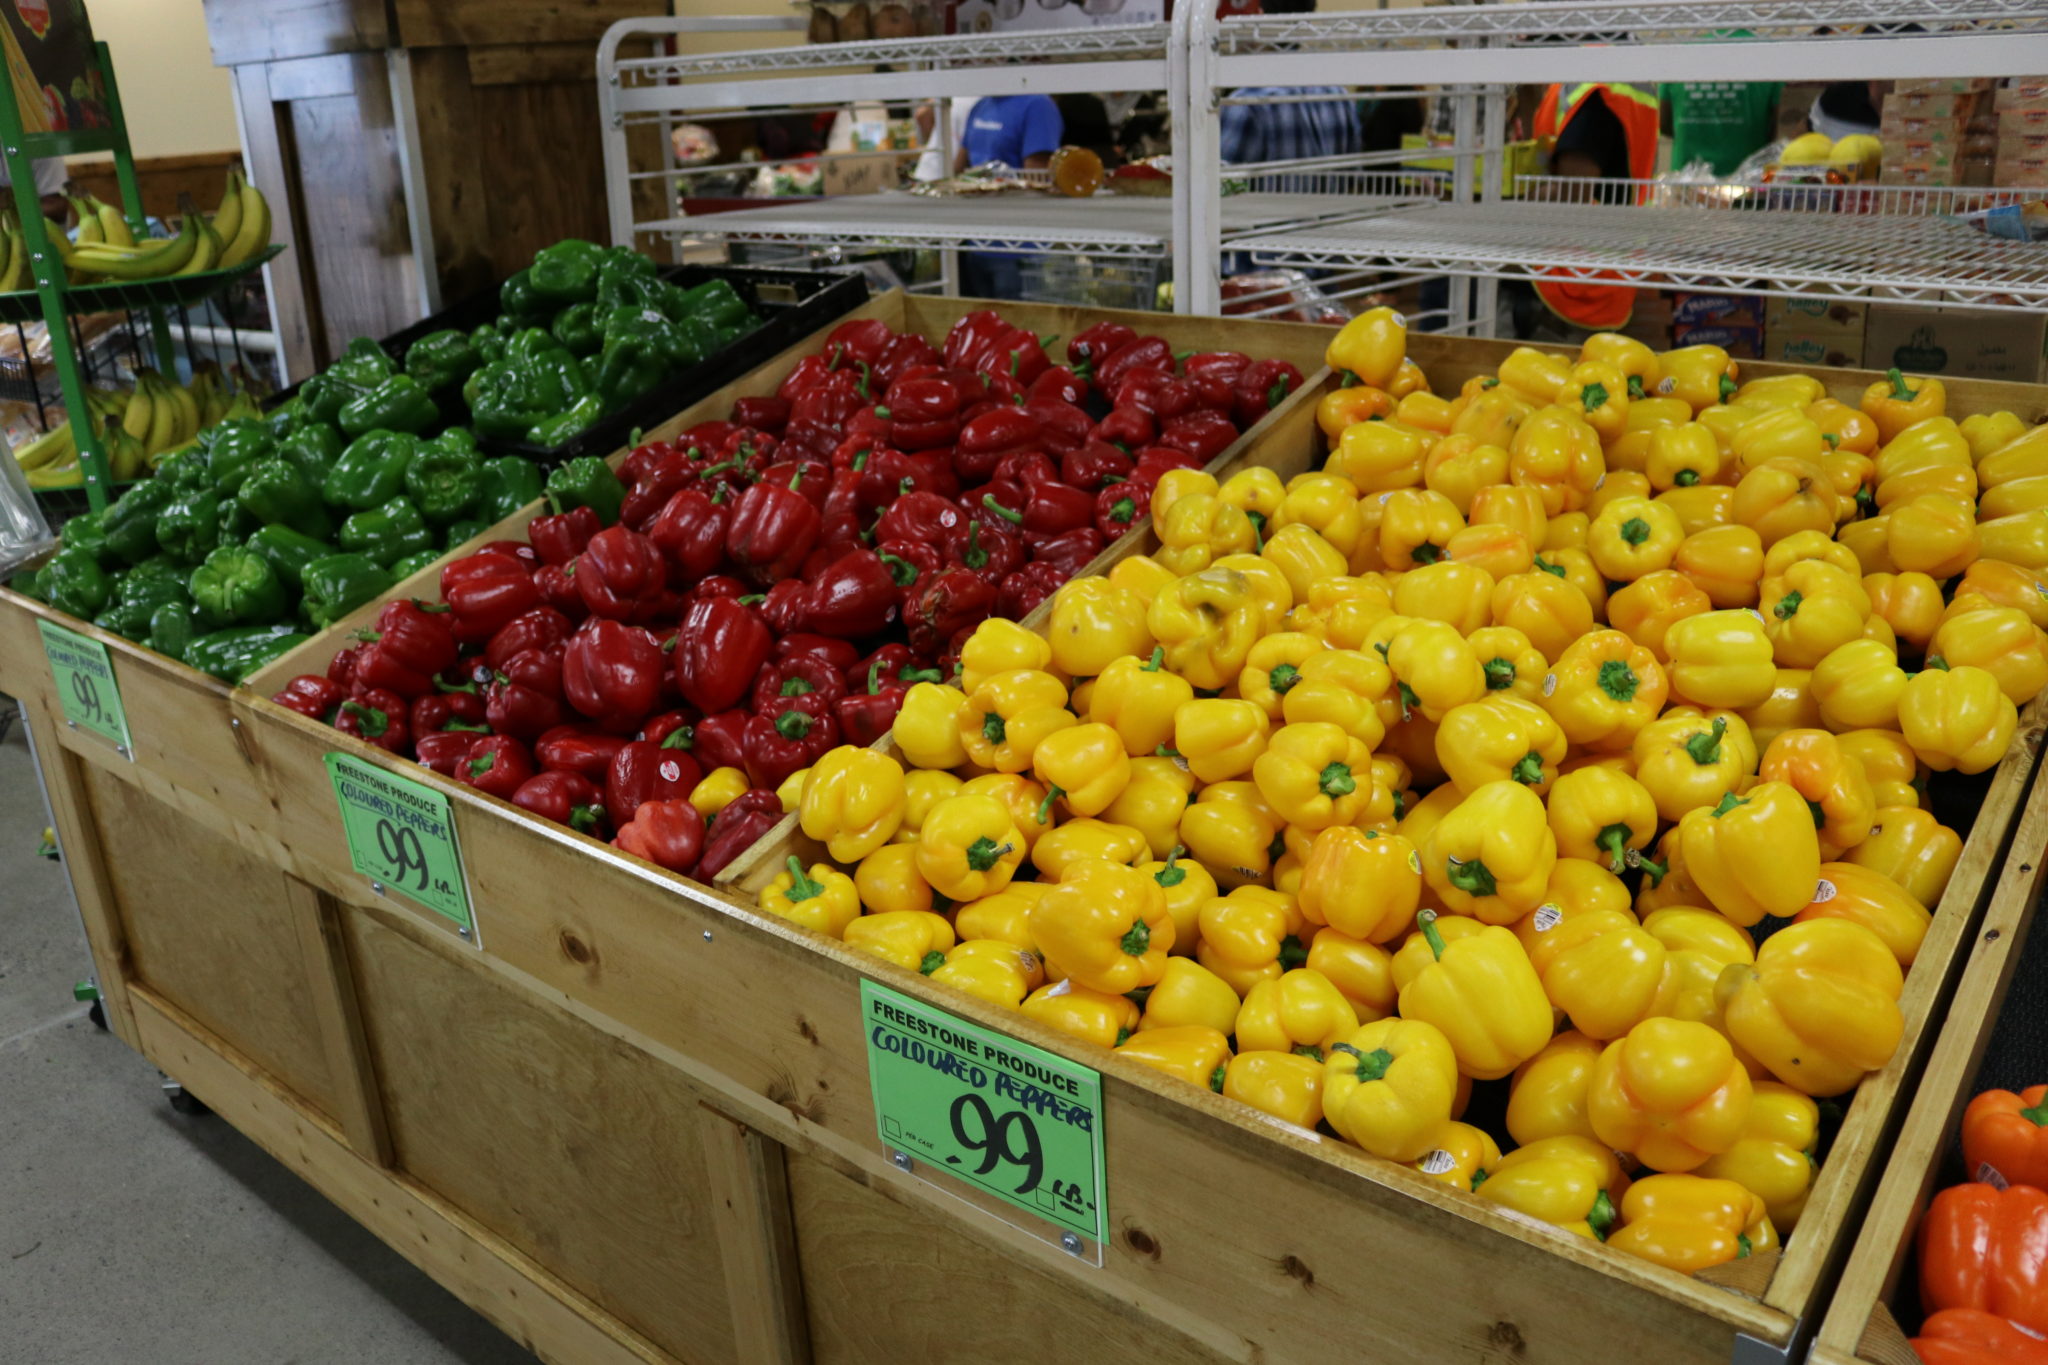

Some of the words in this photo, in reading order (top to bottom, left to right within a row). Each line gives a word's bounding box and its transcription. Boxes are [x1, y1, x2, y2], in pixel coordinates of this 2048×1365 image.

[336, 762, 389, 794] FREESTONE
[390, 786, 438, 817] PRODUCE
[340, 781, 393, 816] COLOURED
[395, 803, 448, 841] PEPPERS
[376, 819, 429, 891] .99
[871, 1025, 988, 1089] COLOURED
[994, 1067, 1094, 1133] PEPPERS
[873, 999, 979, 1057] FREESTONE
[983, 1045, 1080, 1097] PRODUCE
[917, 1138, 935, 1150] CASE
[946, 1093, 1044, 1195] .99
